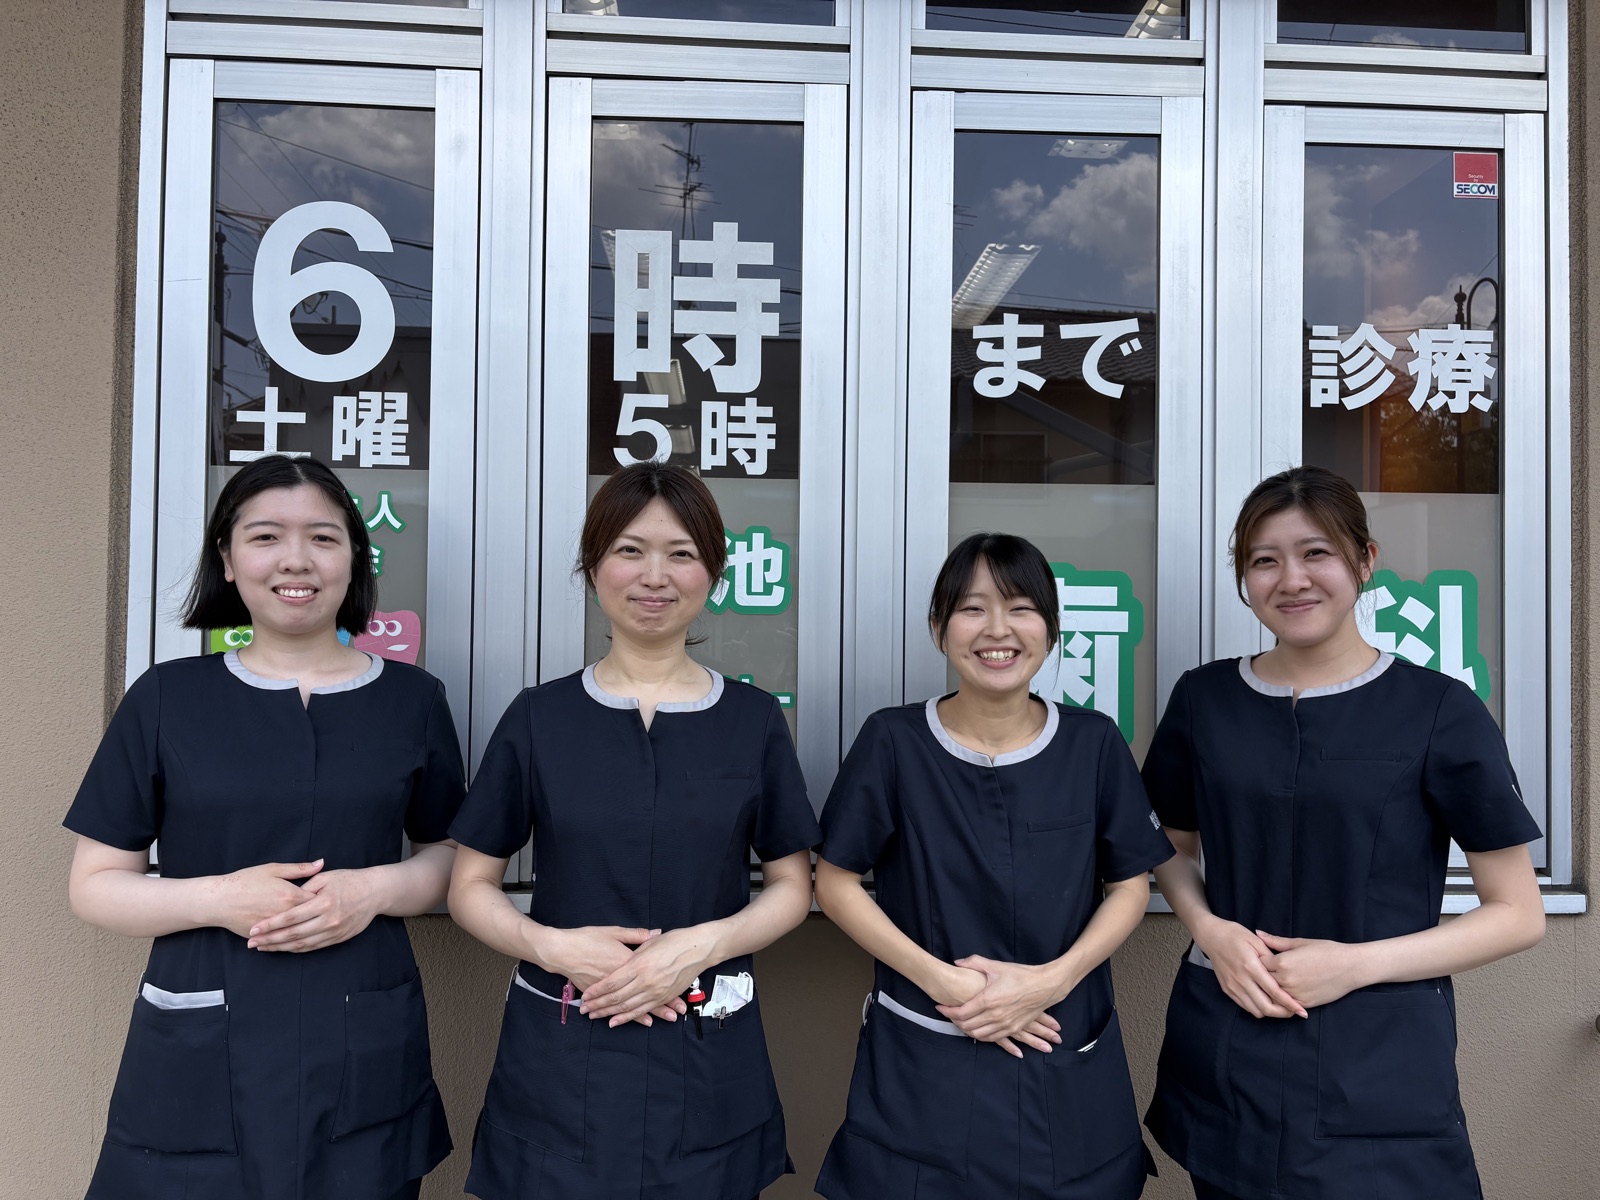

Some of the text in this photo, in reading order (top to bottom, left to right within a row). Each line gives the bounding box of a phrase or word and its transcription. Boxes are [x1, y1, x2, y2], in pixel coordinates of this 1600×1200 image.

[1456, 184, 1496, 195] SECOM
[252, 201, 1496, 413] 6 時 まで 診療
[229, 386, 410, 468] 土曜
[352, 494, 402, 529] 人
[710, 532, 785, 607] 池
